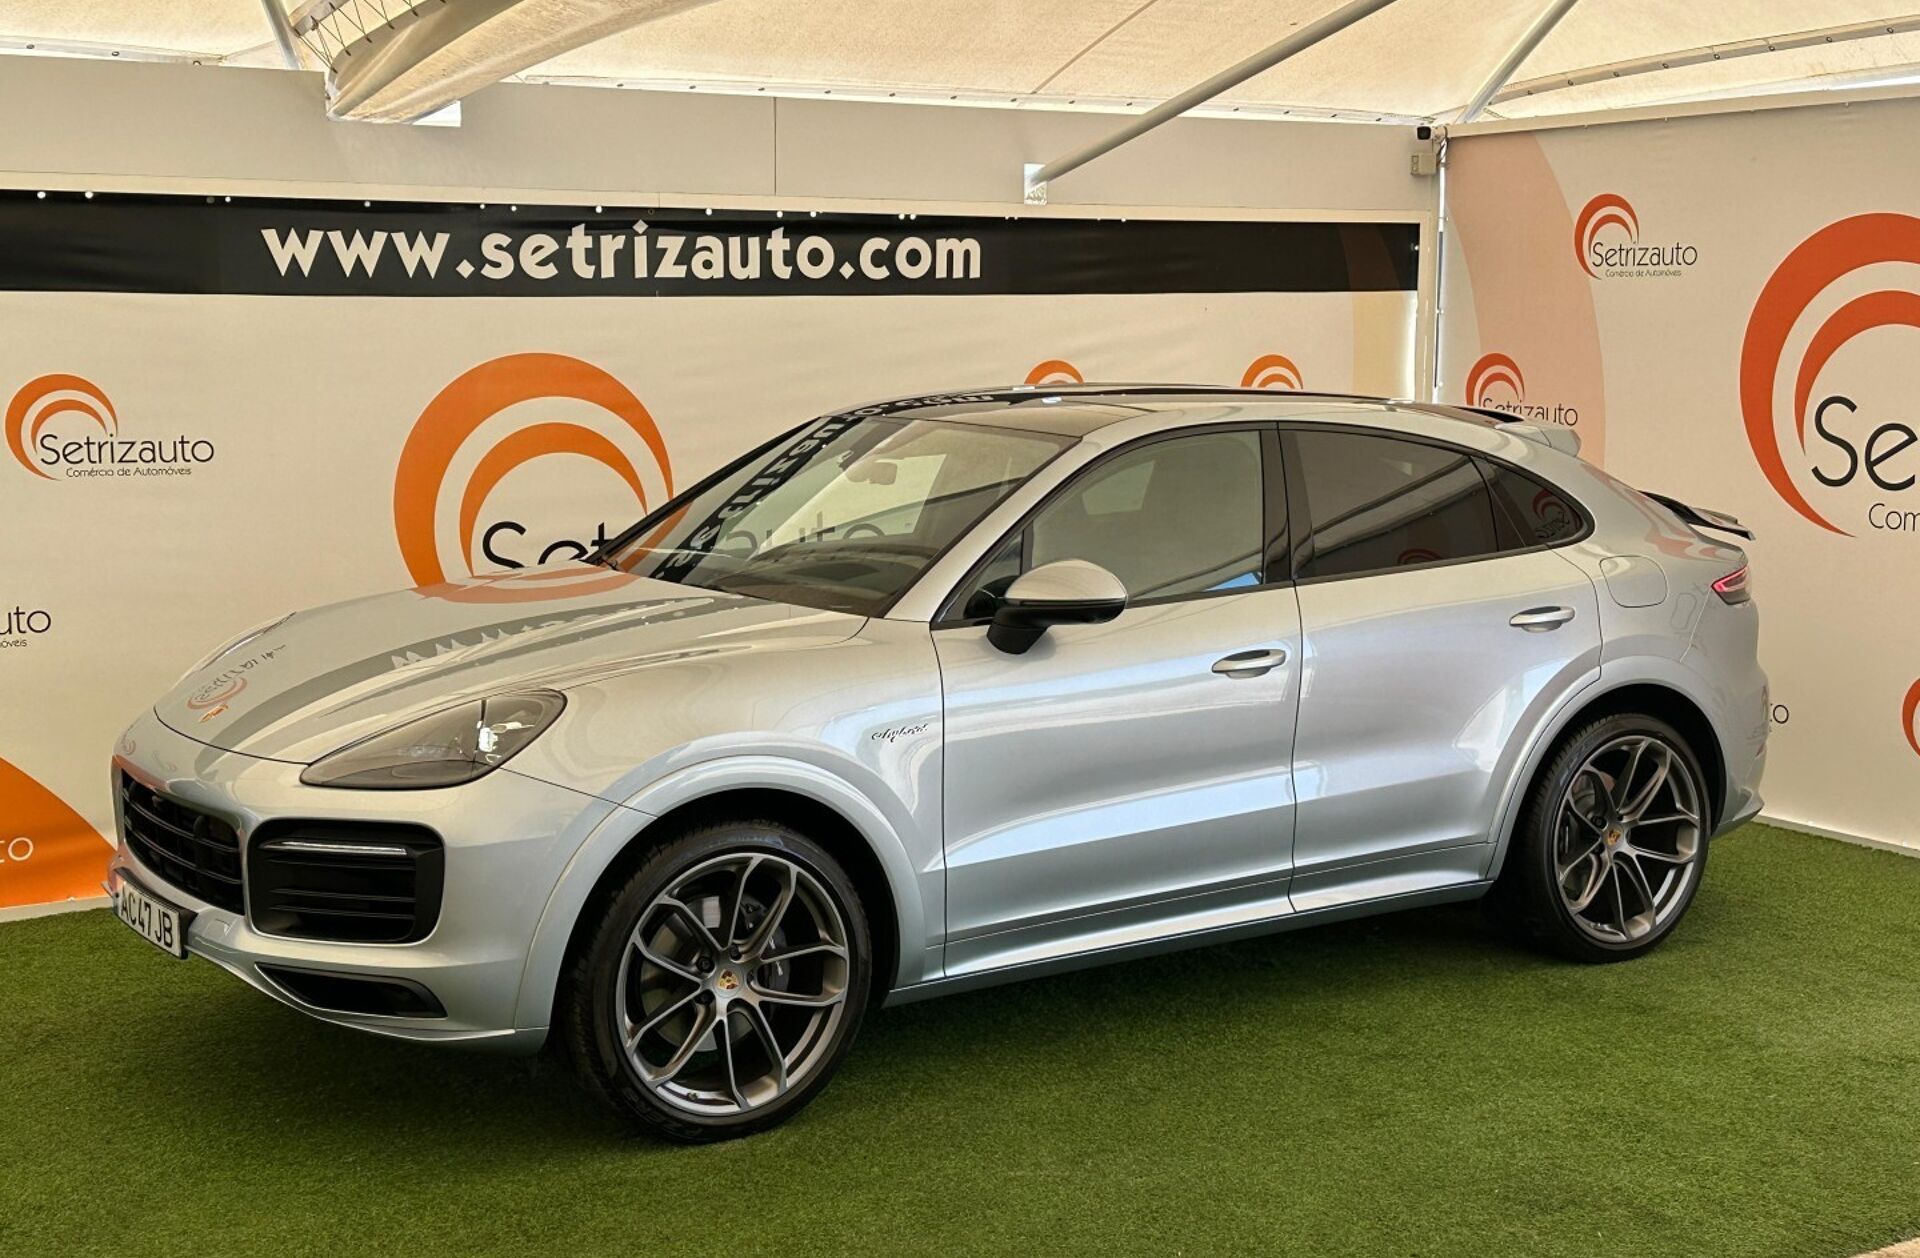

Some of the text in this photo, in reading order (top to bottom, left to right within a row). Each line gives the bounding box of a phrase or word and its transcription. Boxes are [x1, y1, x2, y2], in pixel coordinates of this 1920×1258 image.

[261, 220, 983, 281] www.setrizauto.com
[1592, 242, 1698, 267] Setrizauto
[40, 433, 215, 465] Setrizauto
[1811, 395, 1919, 491] Se
[66, 466, 192, 478] Comércio de Automóveis
